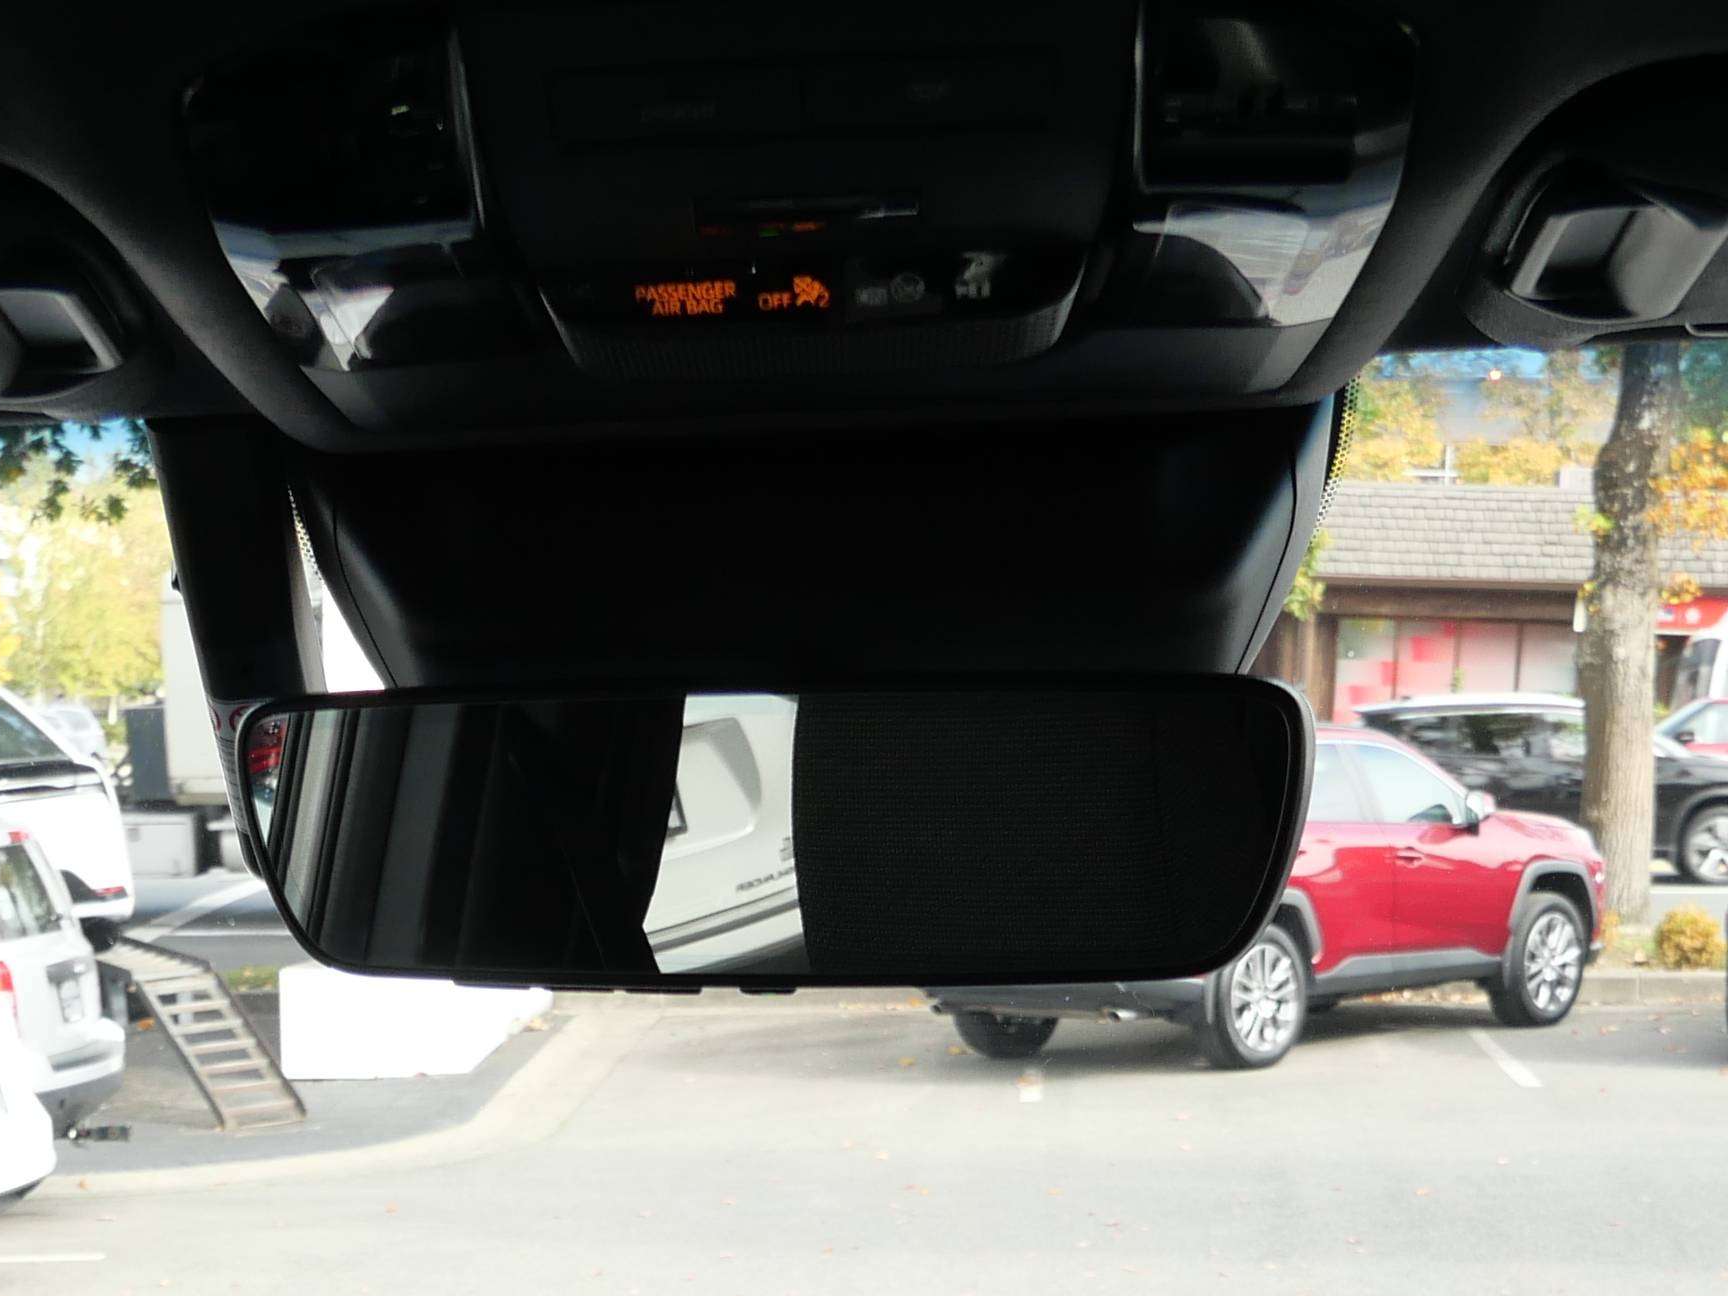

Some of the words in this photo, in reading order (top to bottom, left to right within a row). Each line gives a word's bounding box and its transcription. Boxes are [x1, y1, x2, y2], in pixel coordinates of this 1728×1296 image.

[634, 278, 736, 302] PASSENGER
[757, 290, 792, 312] OFF
[652, 299, 682, 318] AIR
[684, 298, 725, 317] BAG
